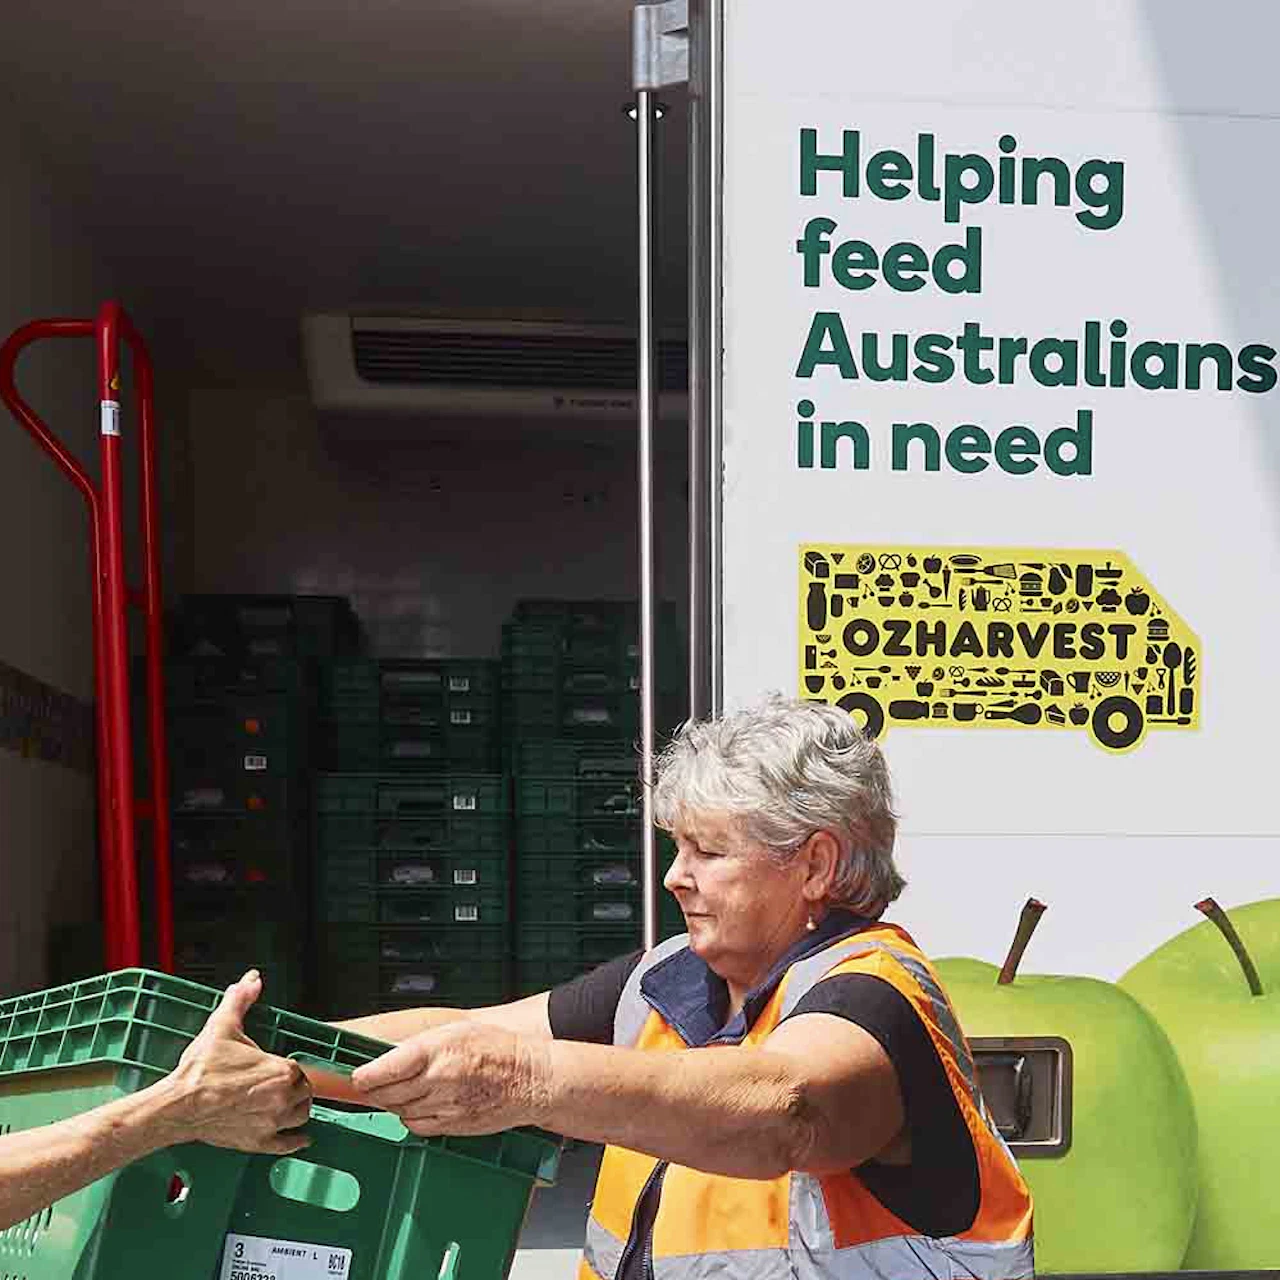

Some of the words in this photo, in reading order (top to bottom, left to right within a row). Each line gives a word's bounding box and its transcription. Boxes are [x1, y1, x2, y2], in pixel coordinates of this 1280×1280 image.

[799, 127, 1125, 231] Helping
[796, 217, 983, 294] feed
[795, 311, 1279, 394] Australians
[796, 399, 870, 470] in
[891, 409, 1094, 477] need
[842, 618, 1137, 660] OZHARVEST
[234, 1242, 244, 1258] 3
[272, 1247, 307, 1257] AMBIENT
